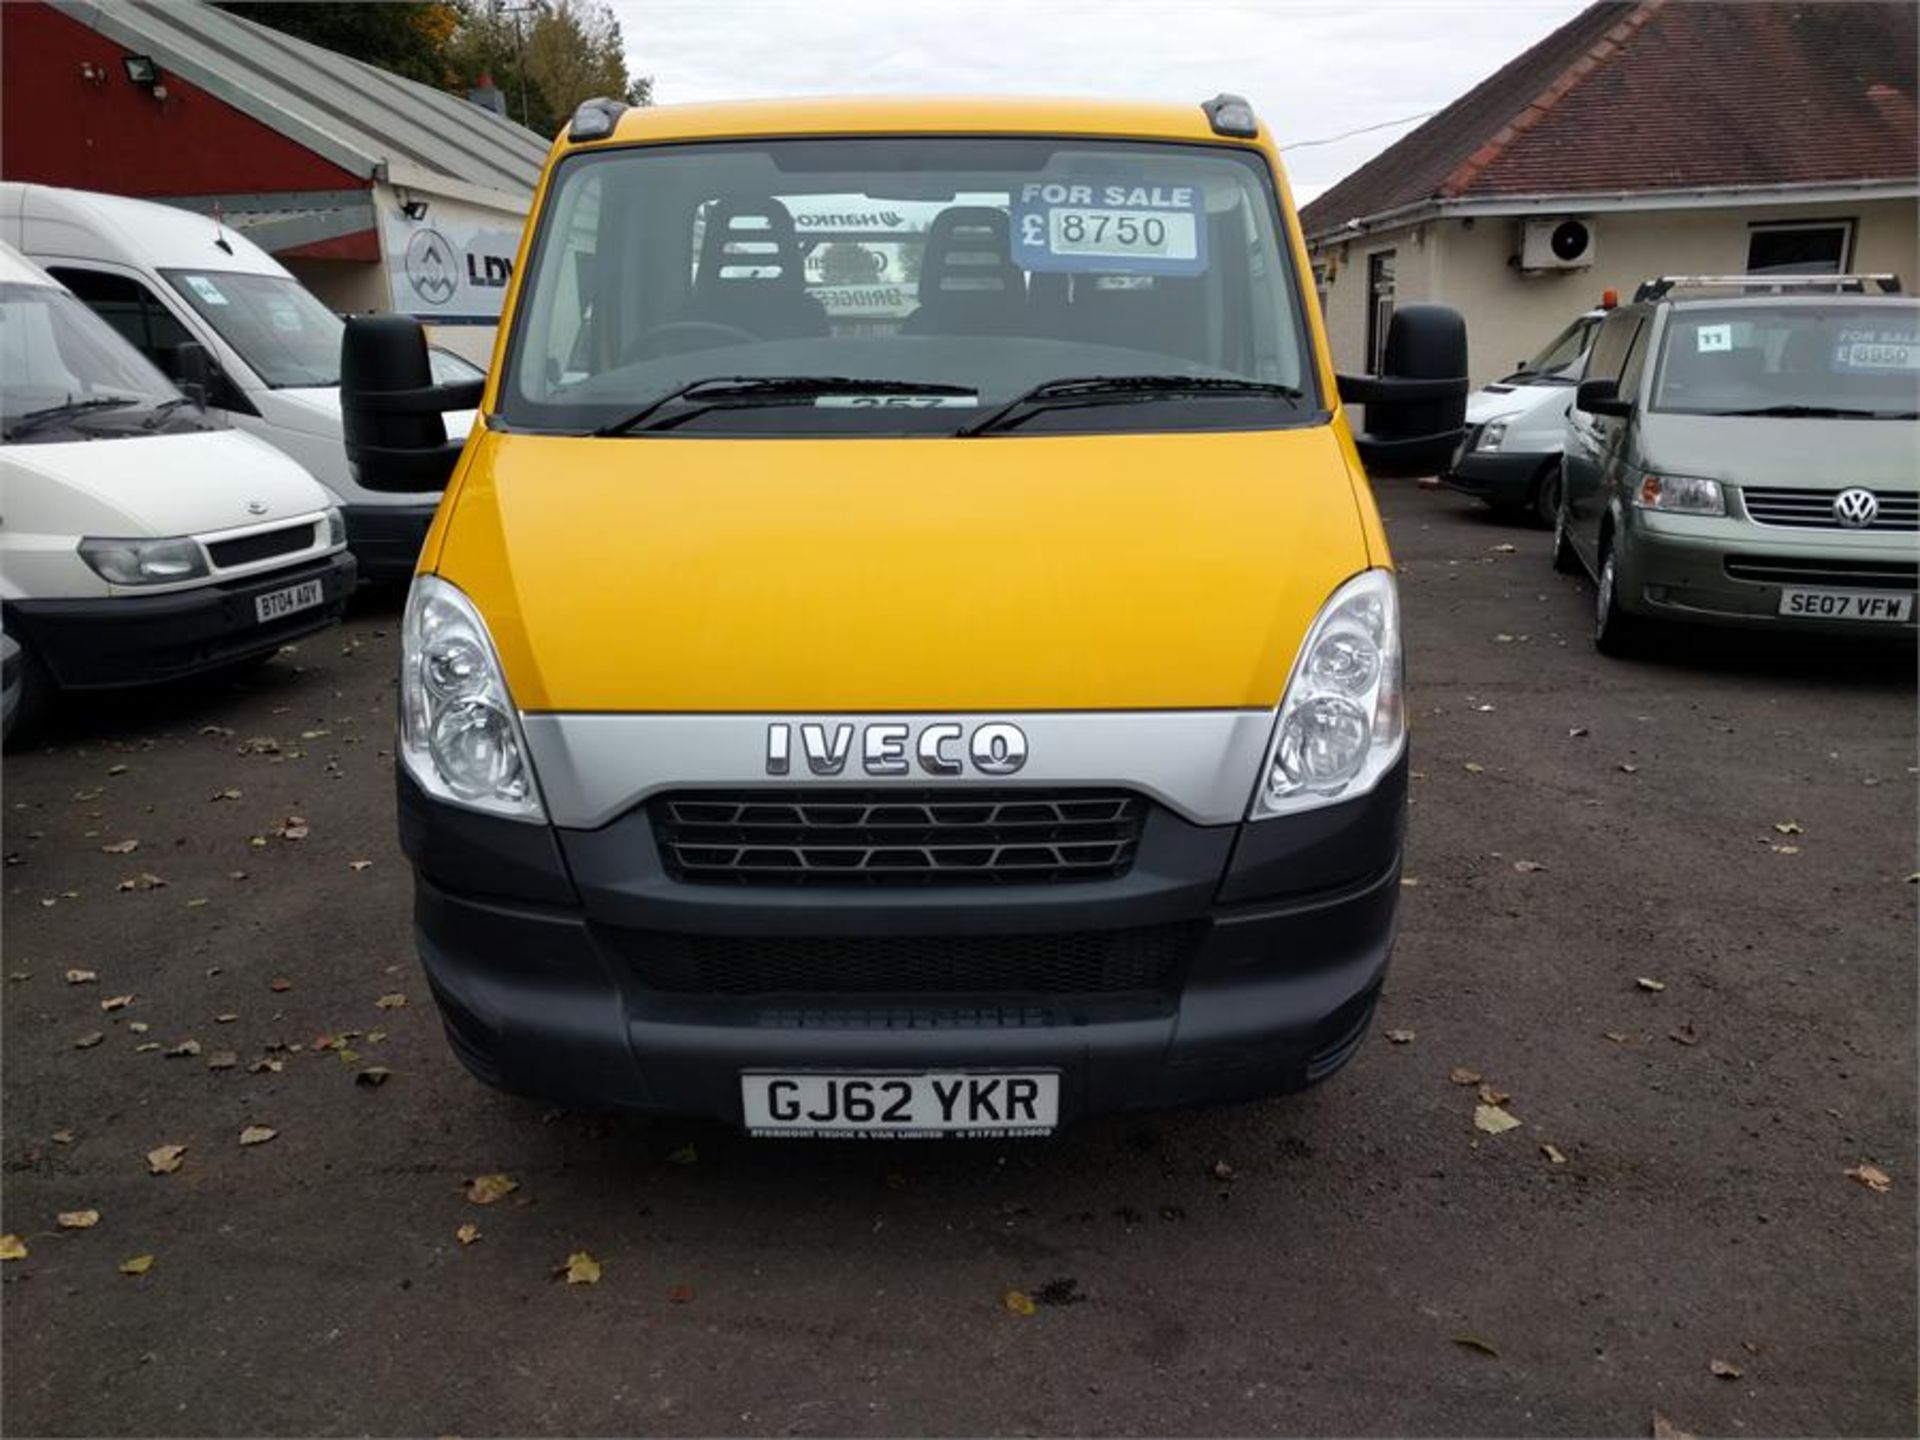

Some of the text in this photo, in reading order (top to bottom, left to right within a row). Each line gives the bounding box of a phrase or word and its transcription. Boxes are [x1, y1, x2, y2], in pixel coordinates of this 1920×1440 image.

[1022, 184, 1192, 207] FOR SALE
[1022, 213, 1165, 246] £ 8750
[262, 590, 293, 616] BT04
[1790, 594, 1902, 618] SE07 VFW
[766, 722, 1029, 776] IVECO
[768, 1078, 1038, 1122] GJ62 YKR
